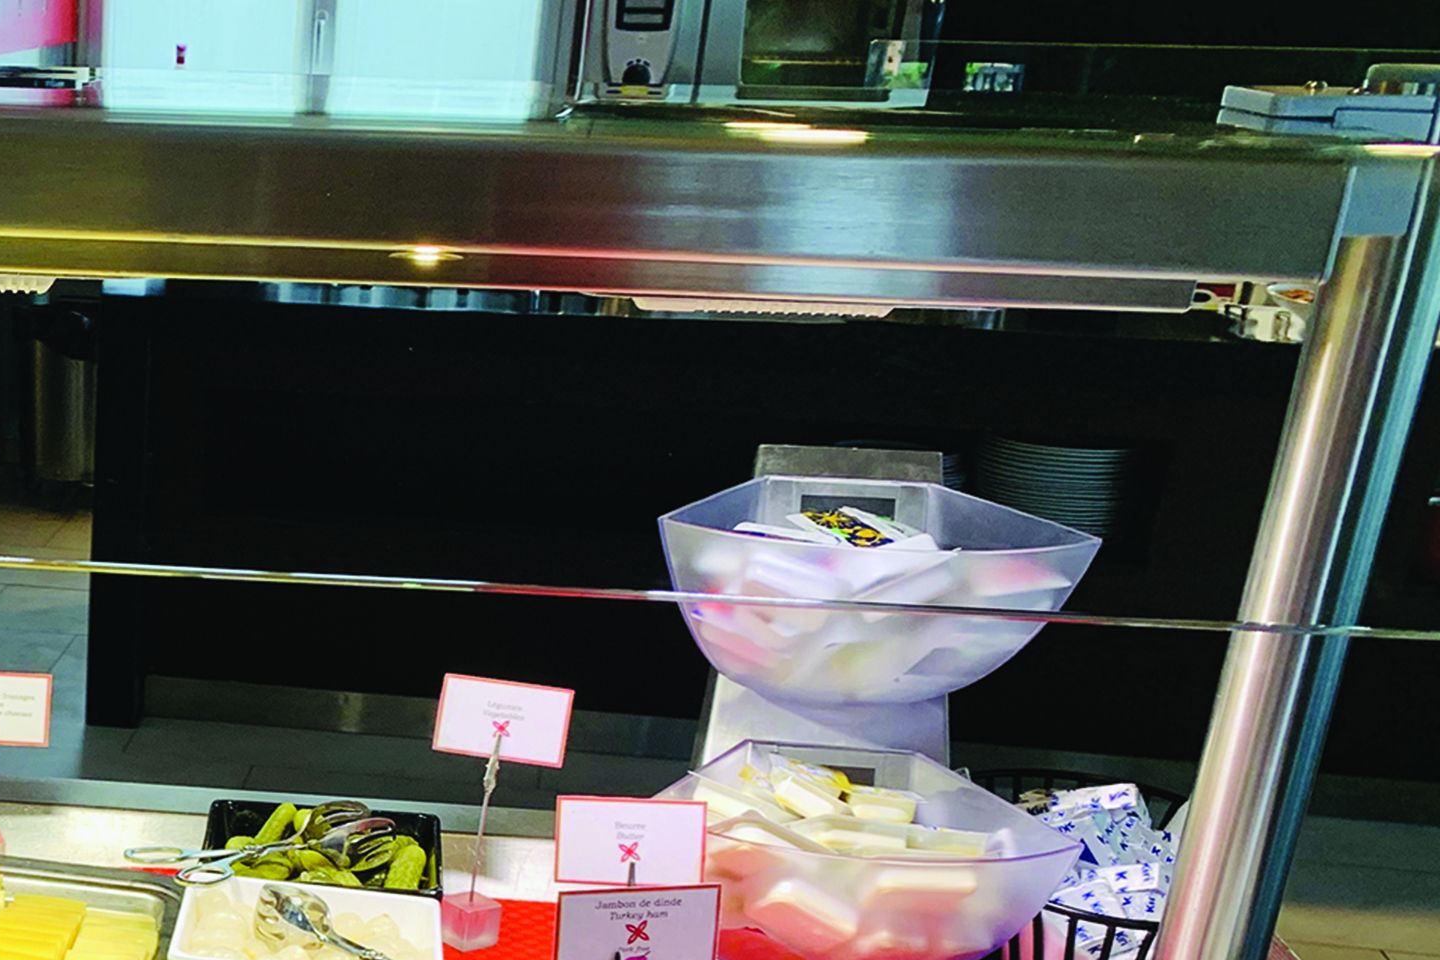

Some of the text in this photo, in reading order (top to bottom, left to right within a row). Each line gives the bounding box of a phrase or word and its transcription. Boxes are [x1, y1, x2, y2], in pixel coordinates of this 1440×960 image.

[595, 898, 683, 910] Jambon de dinde
[610, 910, 669, 921] Turkey ham
